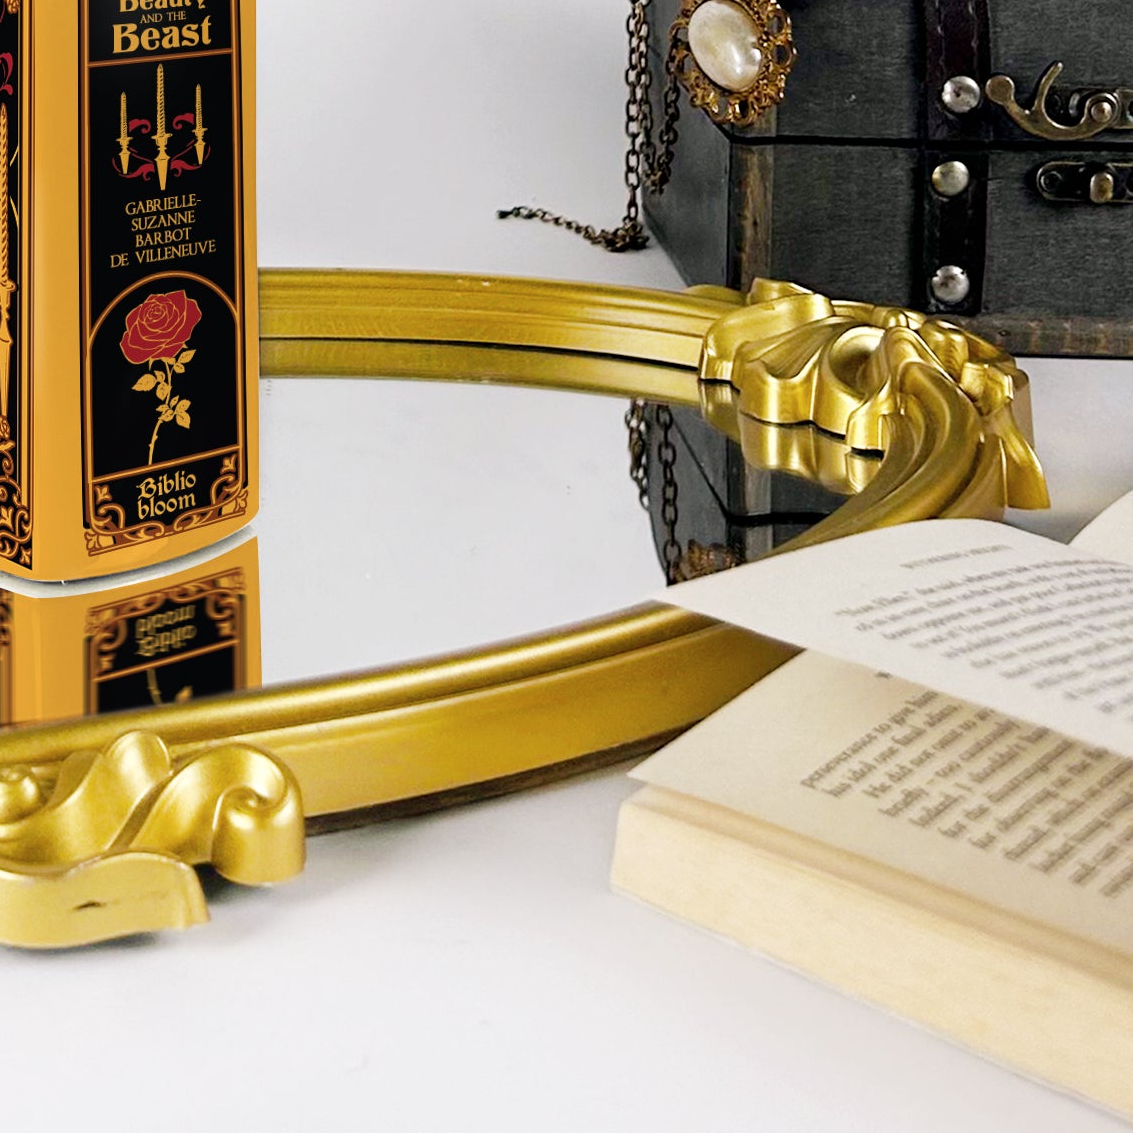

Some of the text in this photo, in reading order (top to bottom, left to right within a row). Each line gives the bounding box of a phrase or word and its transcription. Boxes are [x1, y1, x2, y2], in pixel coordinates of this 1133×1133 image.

[140, 11, 187, 24] AND THE
[113, 15, 212, 54] Beast
[125, 194, 201, 215] GABRIELLE-
[131, 210, 196, 231] SUZANNE
[136, 227, 192, 247] BARBOT
[110, 240, 216, 268] DE VILLENEUVE
[136, 470, 197, 499] Biblio
[138, 493, 196, 520] bloom
